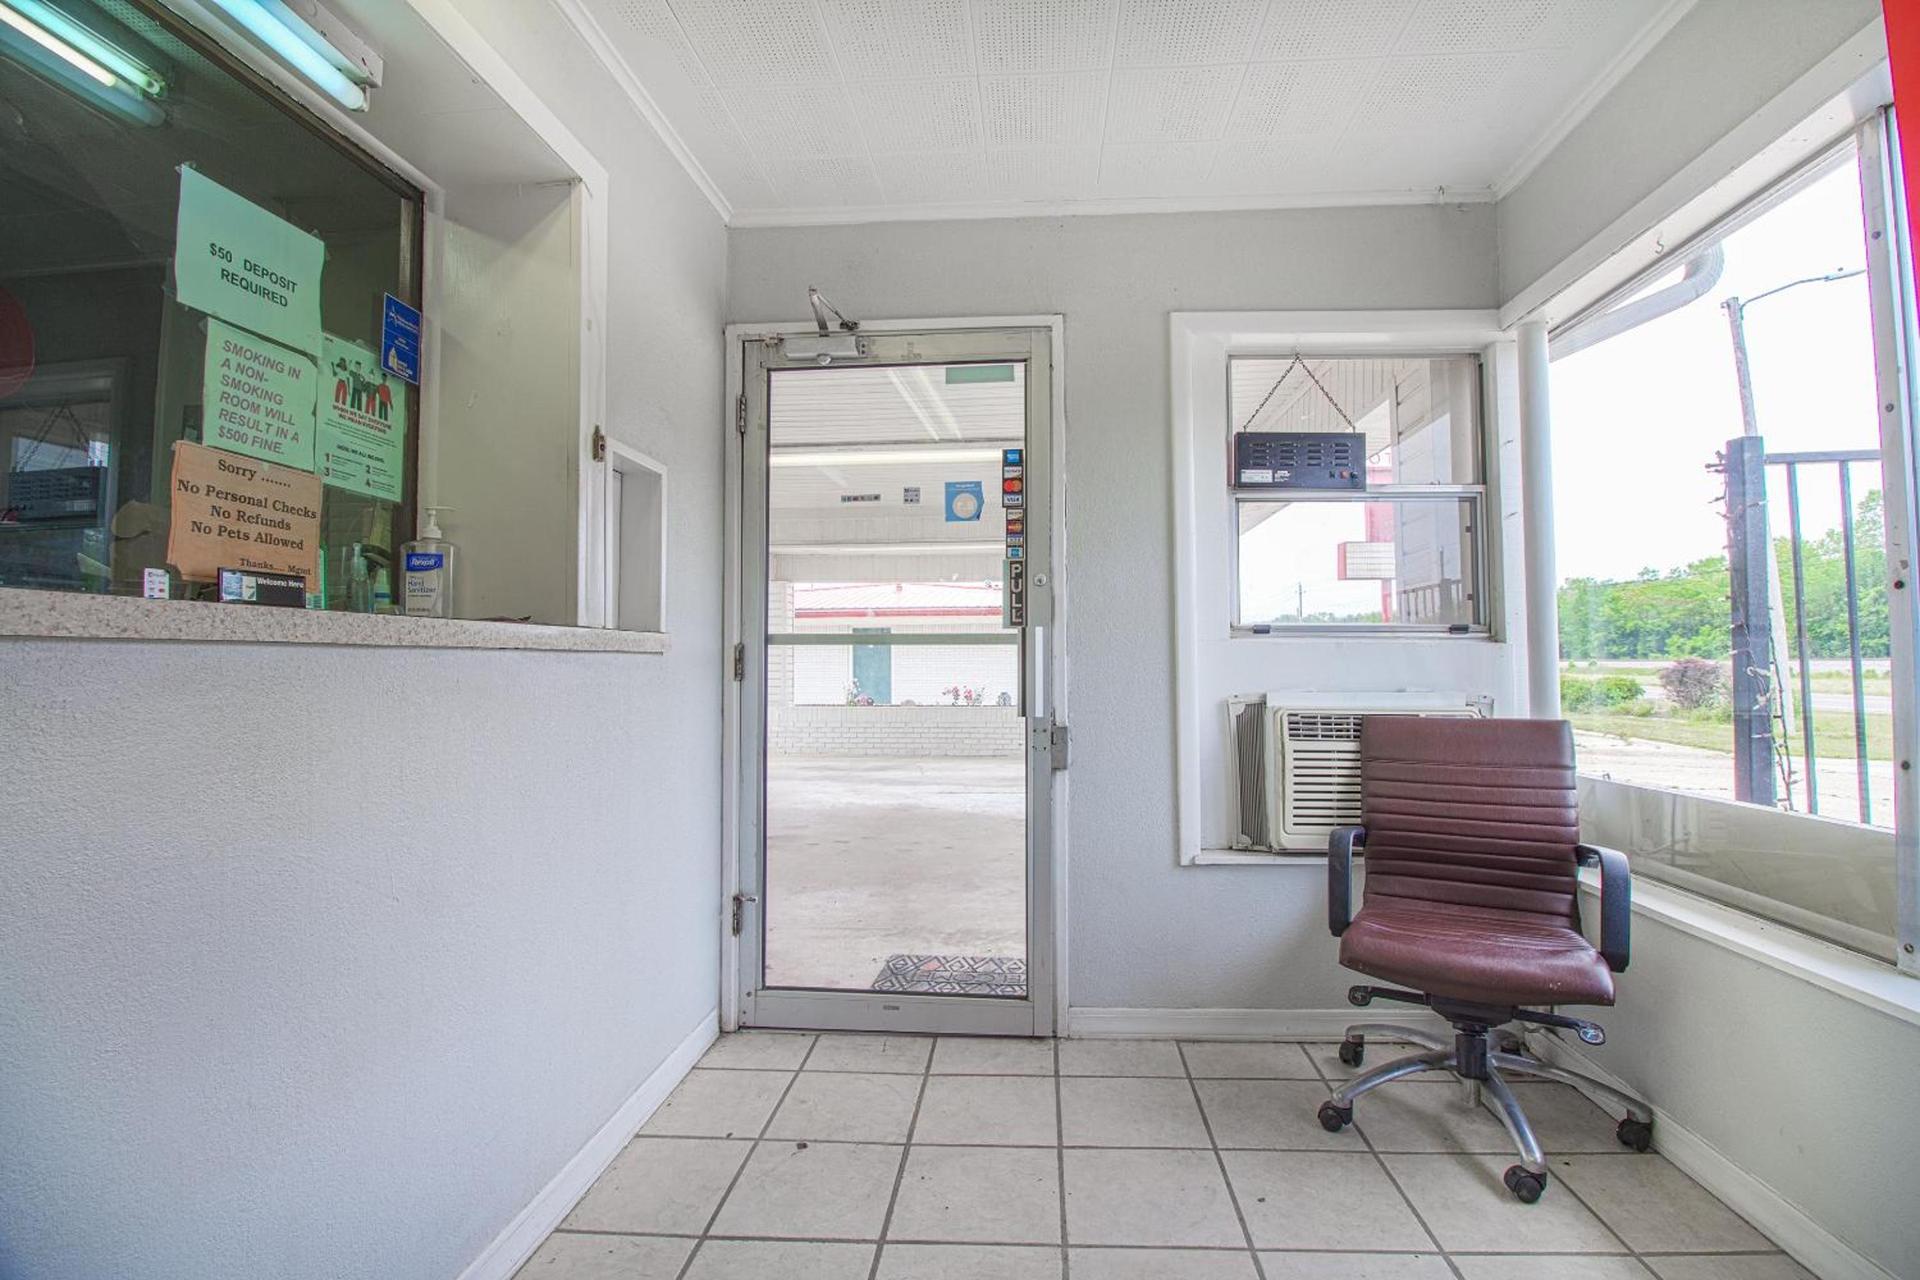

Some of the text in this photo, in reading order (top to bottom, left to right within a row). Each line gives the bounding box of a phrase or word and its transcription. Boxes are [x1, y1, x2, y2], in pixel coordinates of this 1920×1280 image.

[209, 242, 298, 293] $50 DEPOSIT
[221, 268, 288, 307] REQUIRED
[221, 358, 269, 383] A NON-
[223, 339, 301, 379] SMOKING IN
[221, 374, 284, 405] SMOKING
[220, 391, 295, 426] ROOM WILL
[218, 426, 285, 455] $500 FINE.
[219, 408, 300, 443] RESULT IN A
[218, 459, 257, 481] Sorry
[324, 466, 330, 476] 3
[177, 479, 317, 519] No Personal Checks
[210, 505, 292, 531] No Refunds
[191, 520, 304, 550] No Pets Allowed
[257, 576, 304, 589] Welcome Here
[1011, 564, 1022, 622] PULL
